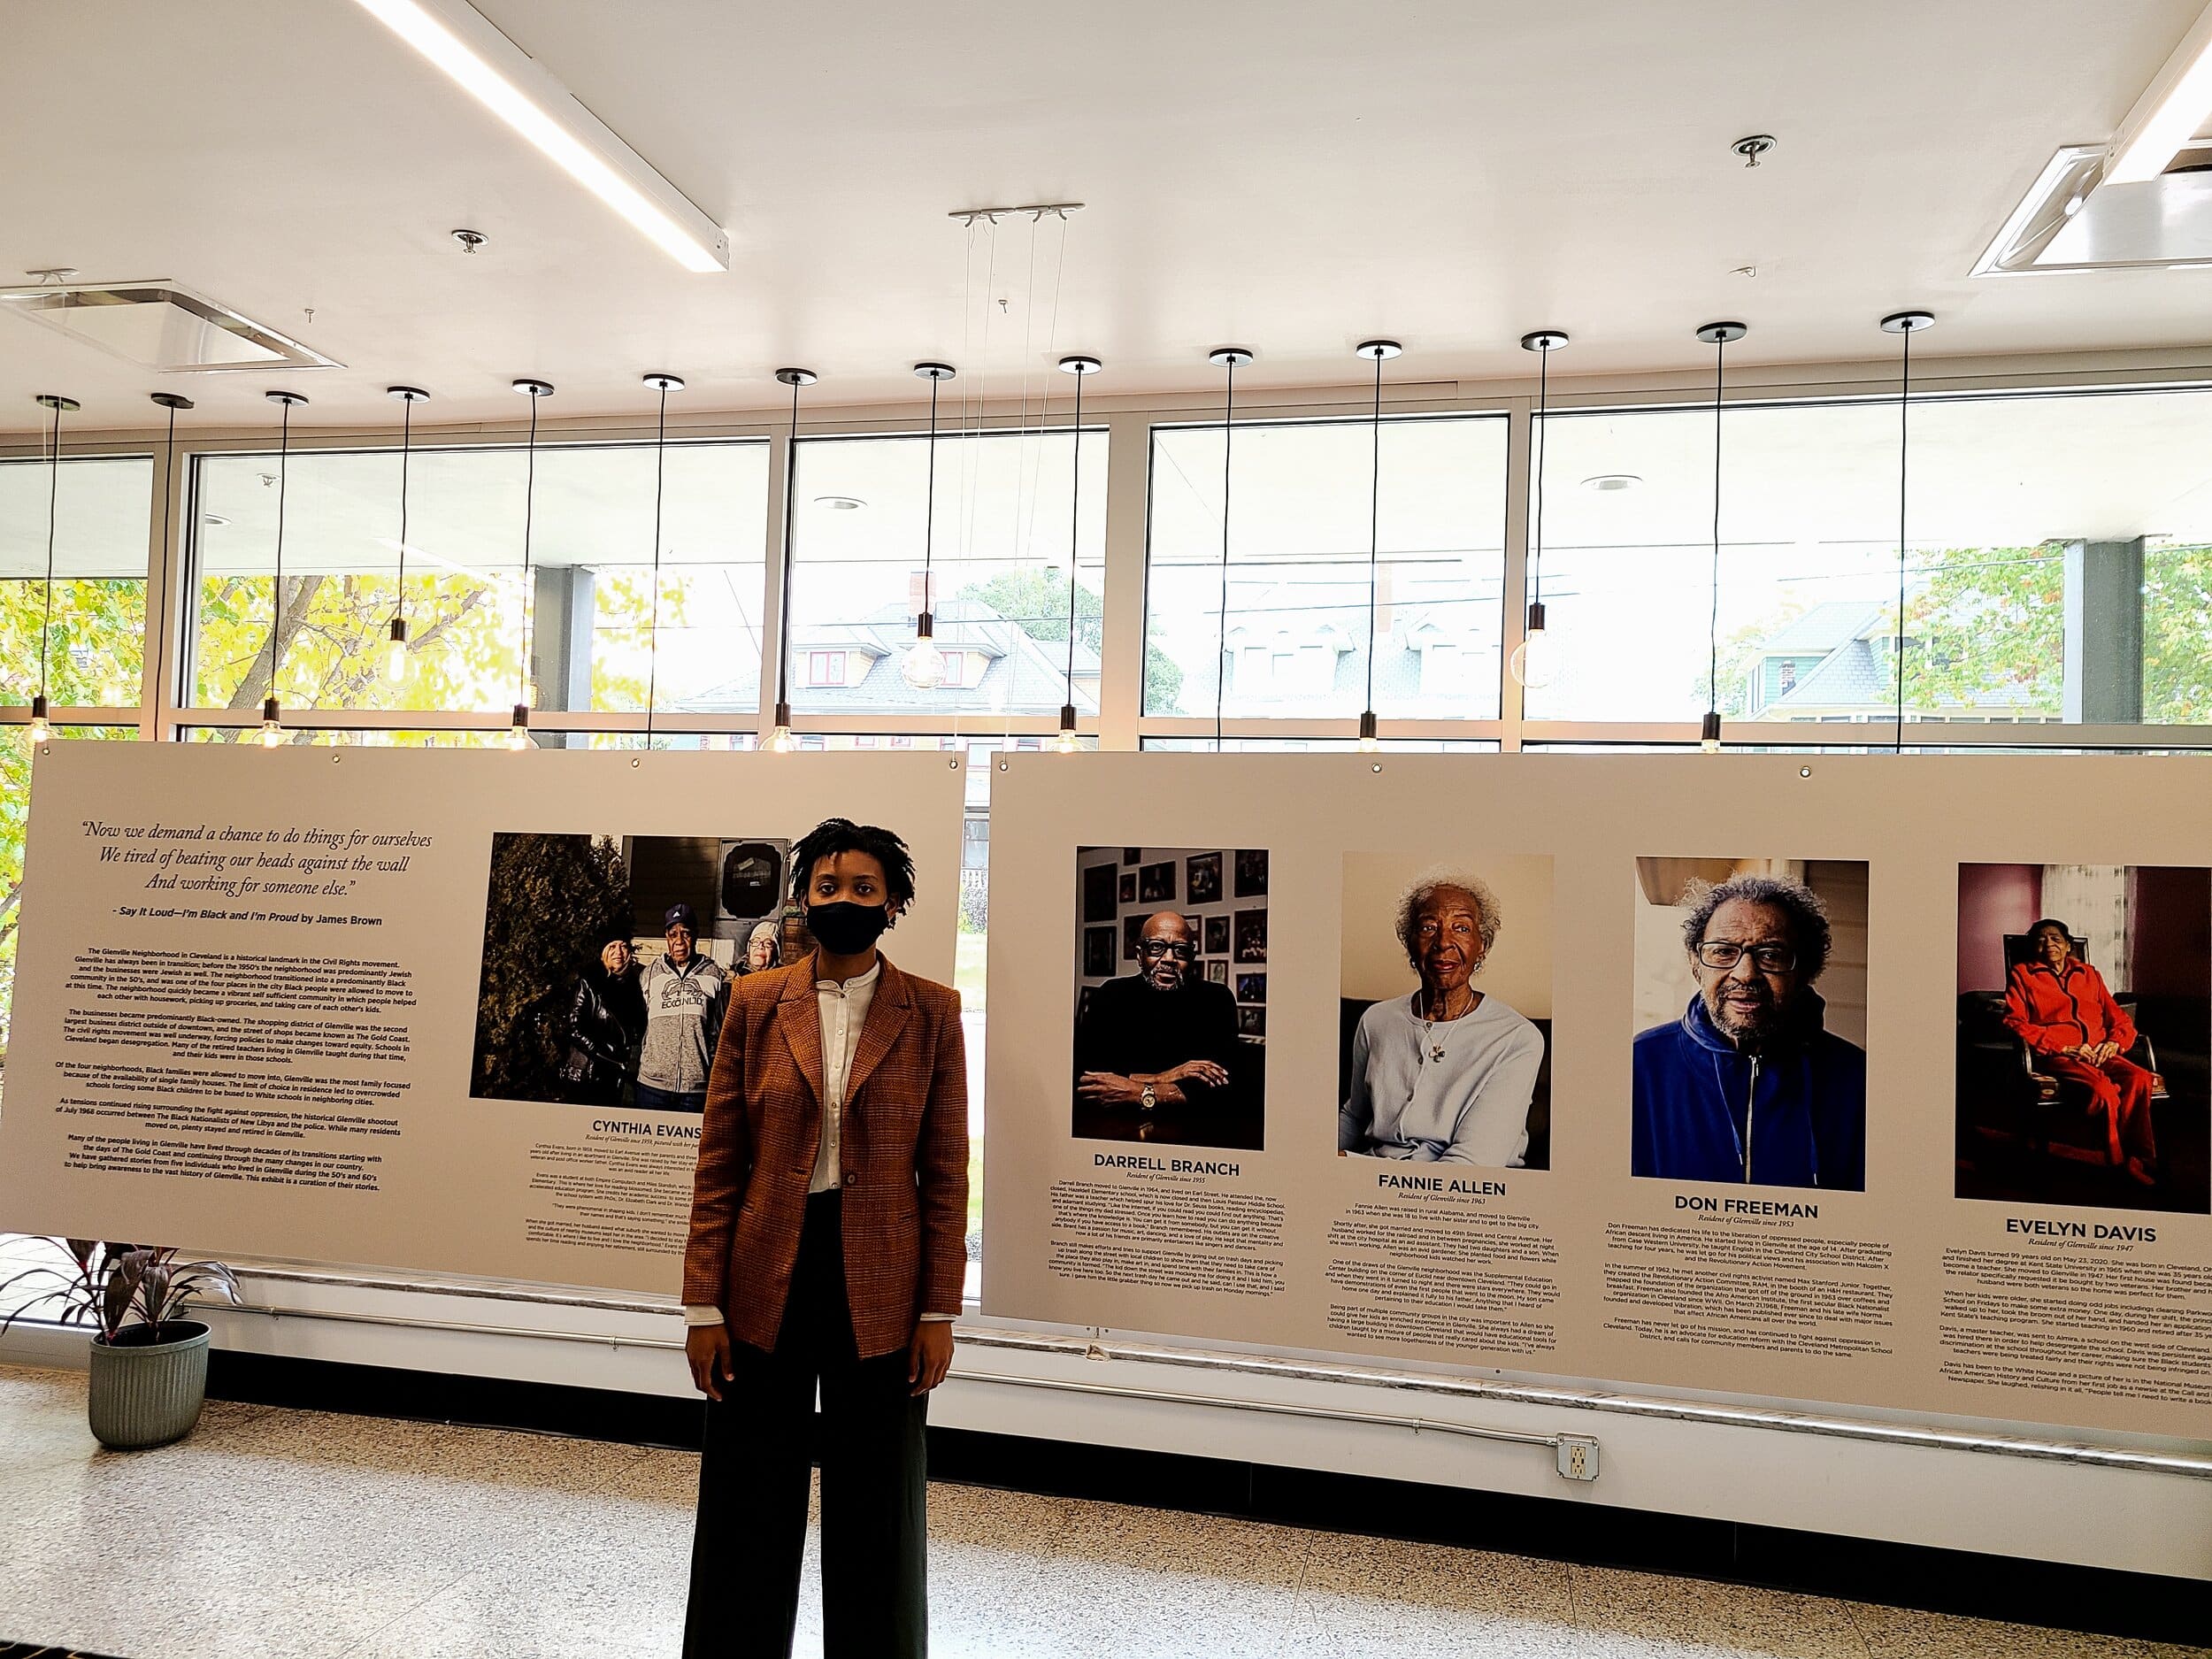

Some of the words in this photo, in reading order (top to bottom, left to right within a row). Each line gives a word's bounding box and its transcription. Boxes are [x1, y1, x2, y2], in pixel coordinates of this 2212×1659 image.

[124, 827, 143, 838] we
[148, 823, 206, 840] demand
[206, 830, 216, 840] a
[219, 826, 264, 841] chance
[266, 826, 280, 842] to
[283, 827, 300, 842] do
[303, 828, 344, 849] things
[344, 829, 369, 849] for
[373, 830, 432, 846] ourselves
[100, 846, 121, 862] We
[124, 847, 158, 864] tired
[159, 849, 179, 869] of
[176, 849, 227, 871] beating
[230, 856, 254, 866] our
[256, 851, 295, 868] heads
[297, 853, 349, 875] against
[351, 855, 373, 871] the
[377, 856, 410, 872] wall
[145, 873, 179, 889] And
[180, 874, 238, 896] working
[236, 876, 261, 897] for
[262, 882, 319, 894] someone
[119, 906, 137, 918] Say
[139, 907, 147, 916] It
[200, 910, 227, 919] Black
[229, 910, 248, 920] and
[269, 912, 299, 922] Proud
[301, 913, 313, 925] by
[316, 914, 348, 924] James
[350, 915, 382, 925] Brown
[132, 949, 180, 959] Neighborhood
[338, 959, 360, 968] Rights
[593, 1120, 651, 1135] CYNTHIA
[657, 1125, 702, 1139] EVANS
[1094, 1154, 1165, 1171] DARRELL
[1171, 1160, 1240, 1177] BRANCH
[1148, 1173, 1155, 1182] of
[1379, 1175, 1442, 1192] FANNIE
[1449, 1180, 1506, 1196] ALLEN
[1423, 1194, 1429, 1202] of
[1675, 1196, 1717, 1211] DON
[1724, 1199, 1818, 1218] FREEMAN
[1725, 1217, 1732, 1225] of
[2007, 1219, 2086, 1237] EVELYN
[2094, 1225, 2156, 1241] DAVIS
[1769, 1233, 1801, 1243] oppressed
[1827, 1238, 1858, 1248] especially
[1859, 1240, 1881, 1249] people
[2058, 1240, 2065, 1249] of
[2067, 1240, 2098, 1249] Glenville
[2128, 1290, 2154, 1299] perfect
